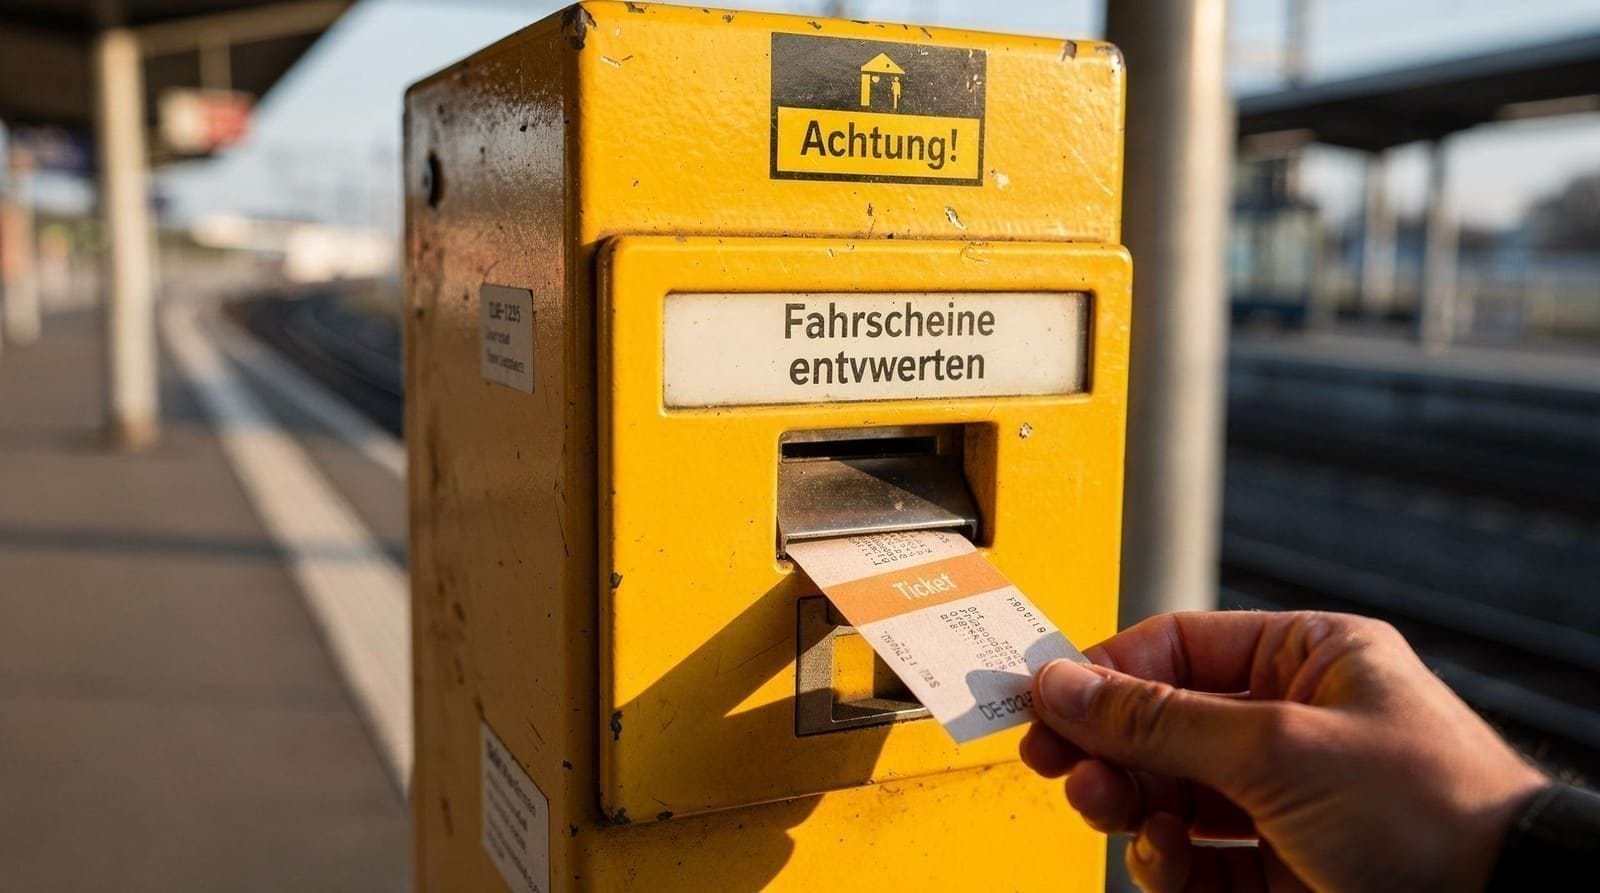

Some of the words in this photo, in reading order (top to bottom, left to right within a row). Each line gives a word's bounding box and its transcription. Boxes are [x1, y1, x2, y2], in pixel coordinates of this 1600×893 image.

[800, 120, 957, 170] Achtung!
[784, 302, 995, 339] Fahrscheine
[892, 572, 956, 600] Ticket
